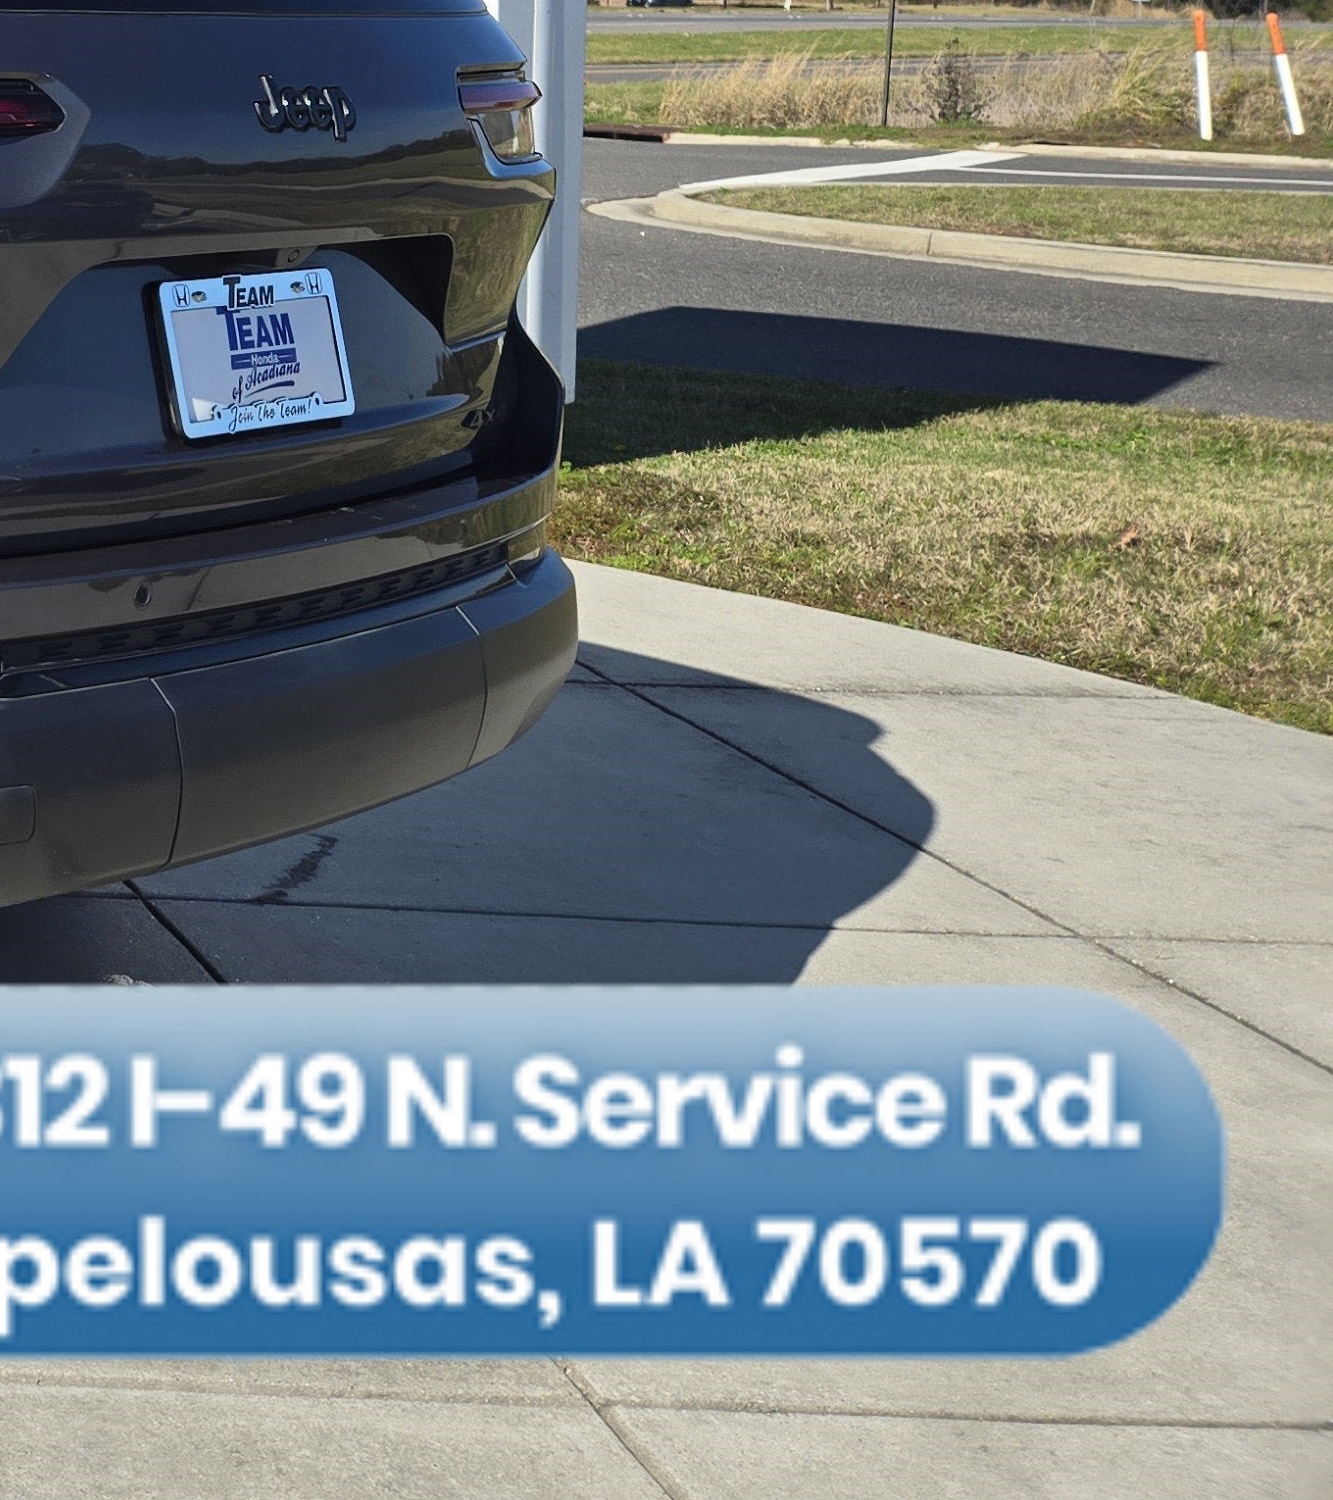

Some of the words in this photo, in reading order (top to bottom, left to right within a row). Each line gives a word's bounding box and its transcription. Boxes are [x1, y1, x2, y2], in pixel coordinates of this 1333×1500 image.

[253, 74, 357, 143] Jeep
[251, 353, 279, 367] Honda
[232, 374, 244, 403] of
[245, 361, 301, 390] Acadiana
[228, 405, 254, 432] Join
[254, 401, 276, 422] The
[275, 397, 312, 419] Team!
